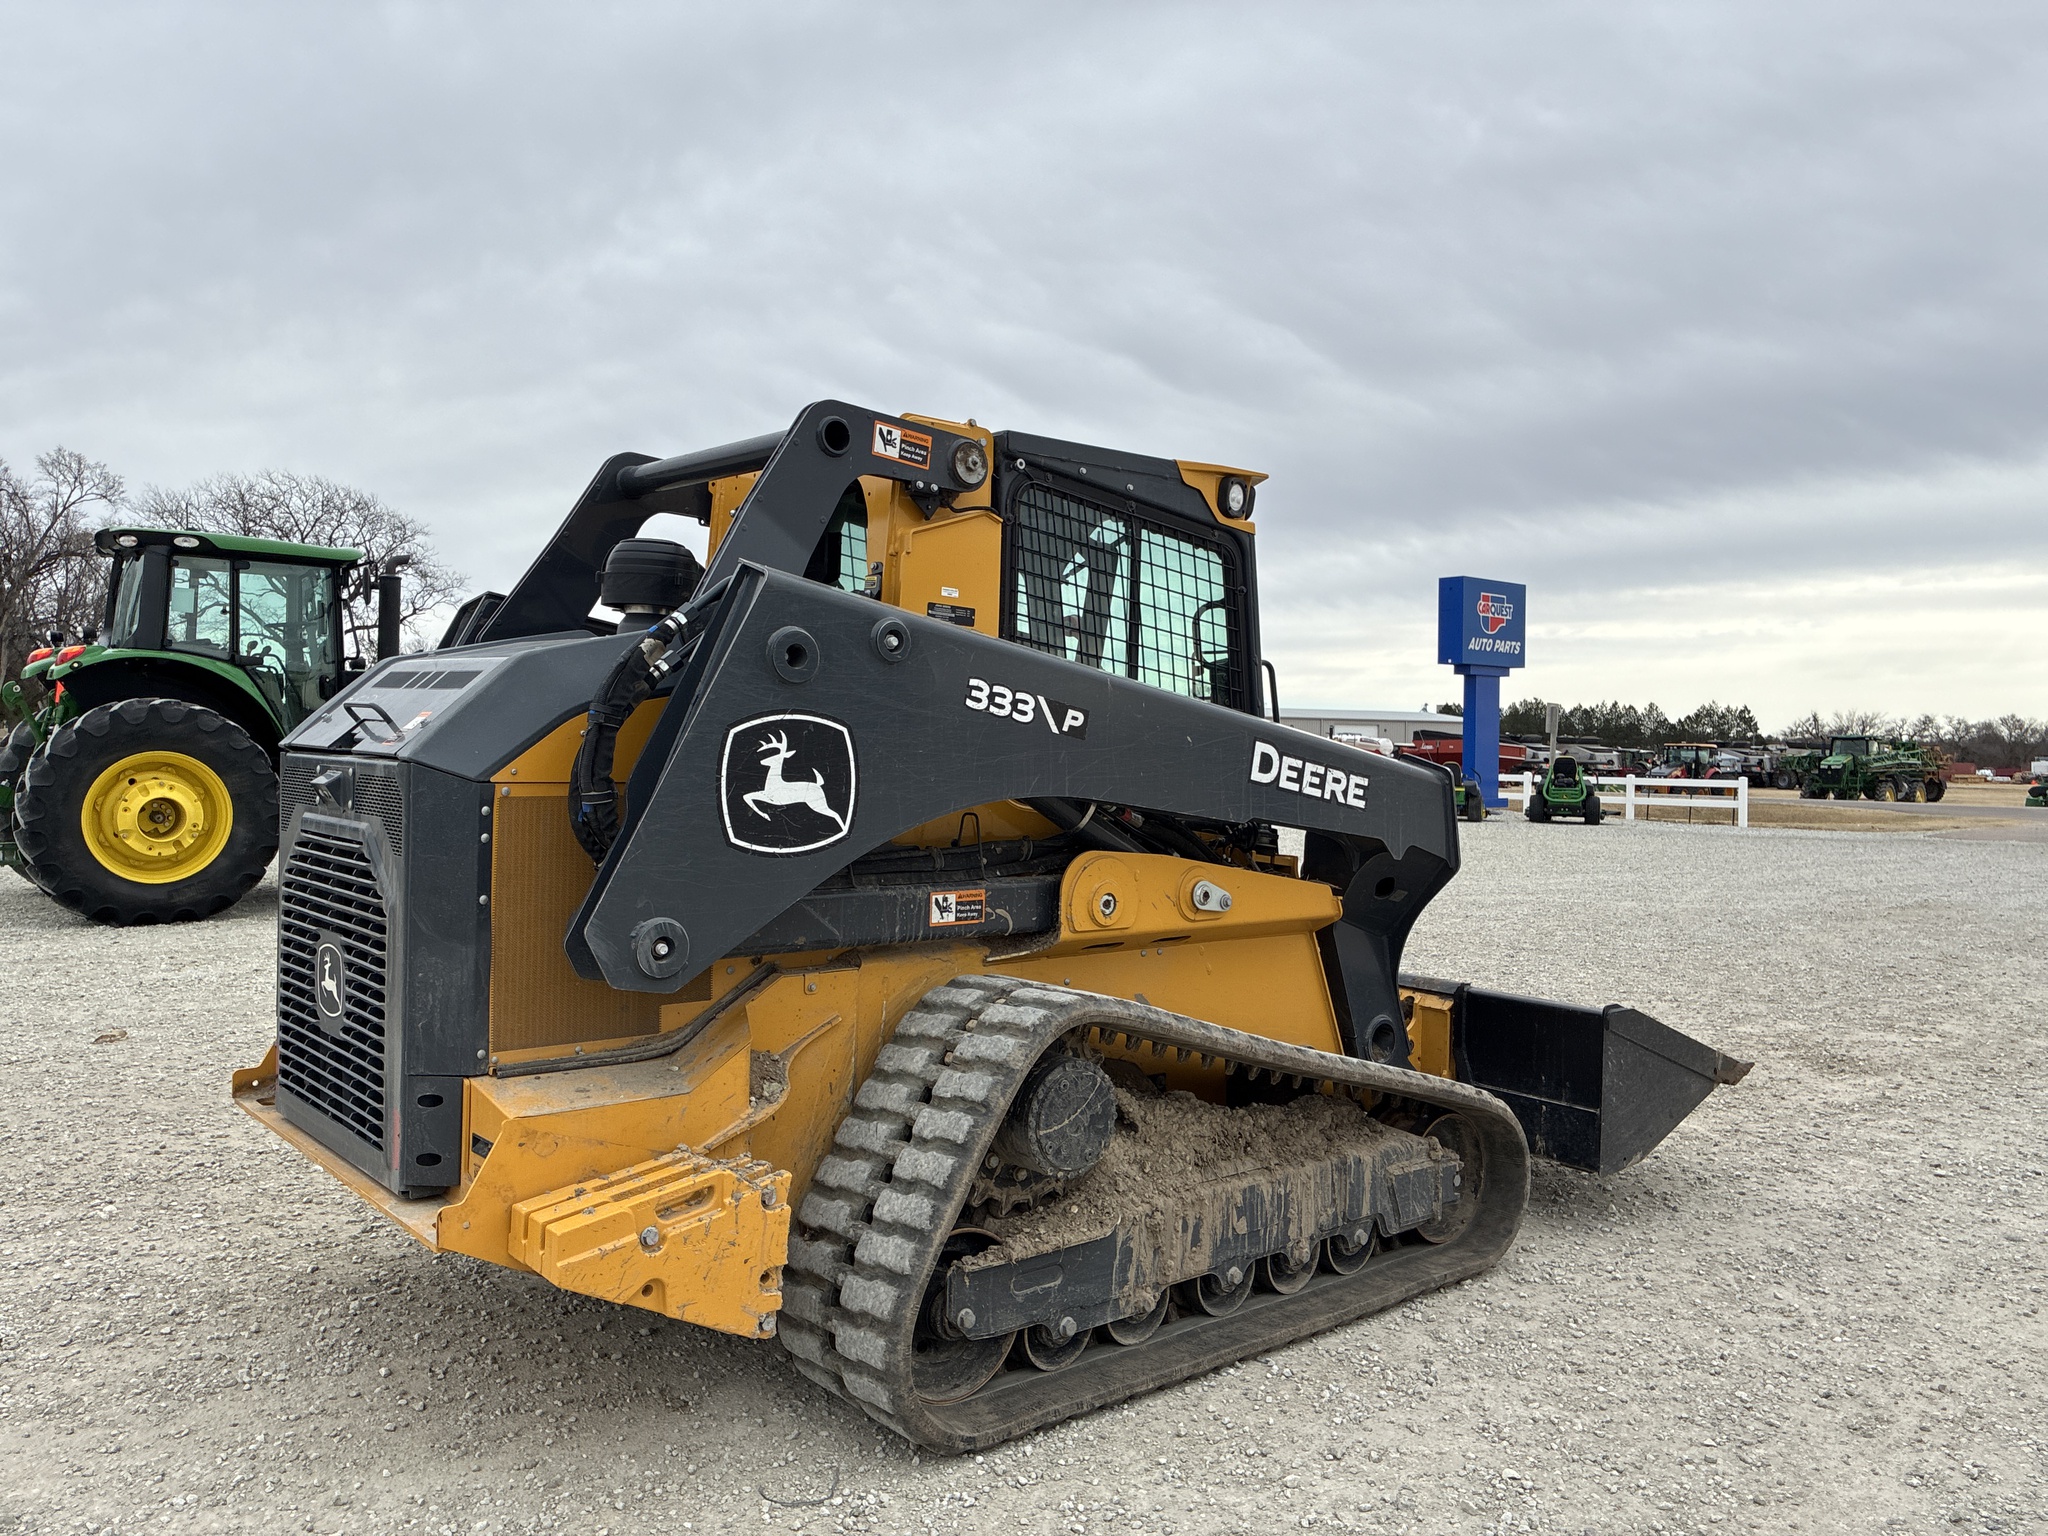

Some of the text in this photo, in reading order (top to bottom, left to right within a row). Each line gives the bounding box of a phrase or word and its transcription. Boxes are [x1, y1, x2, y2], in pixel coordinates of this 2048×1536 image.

[906, 432, 928, 444] WARNING
[901, 443, 915, 452] Pinch
[1478, 602, 1512, 618] CARQUEST
[1468, 637, 1521, 655] AUTO PARTS
[1250, 741, 1369, 809] DEERE
